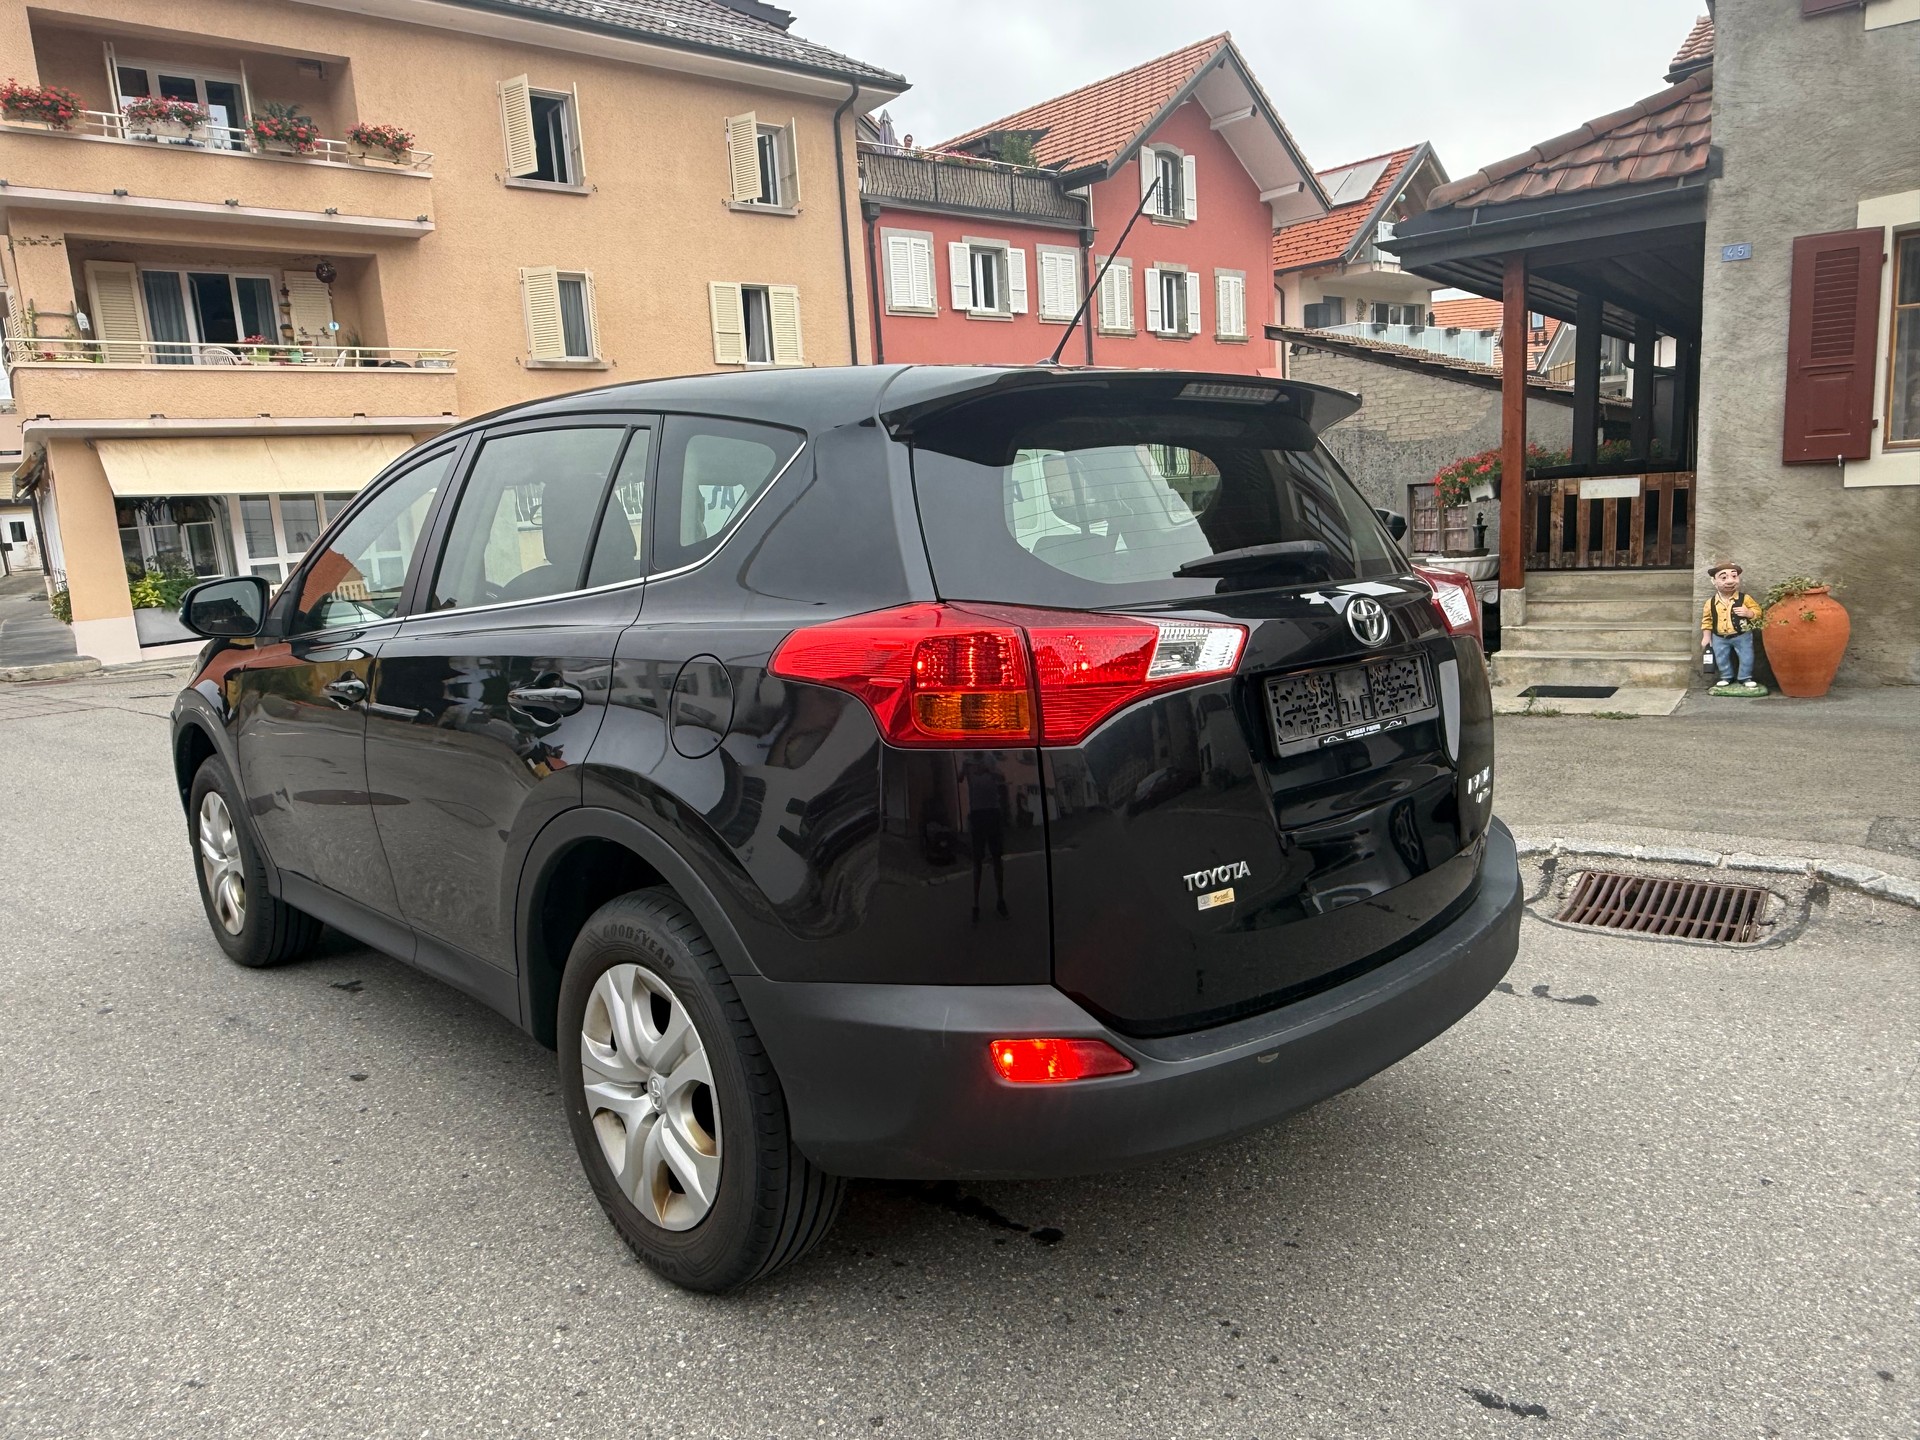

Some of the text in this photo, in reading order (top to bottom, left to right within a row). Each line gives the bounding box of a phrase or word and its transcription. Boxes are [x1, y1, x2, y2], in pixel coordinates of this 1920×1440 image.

[1726, 245, 1746, 257] 45
[1183, 860, 1252, 892] TOYOTA
[602, 923, 676, 970] GOODYEAR
